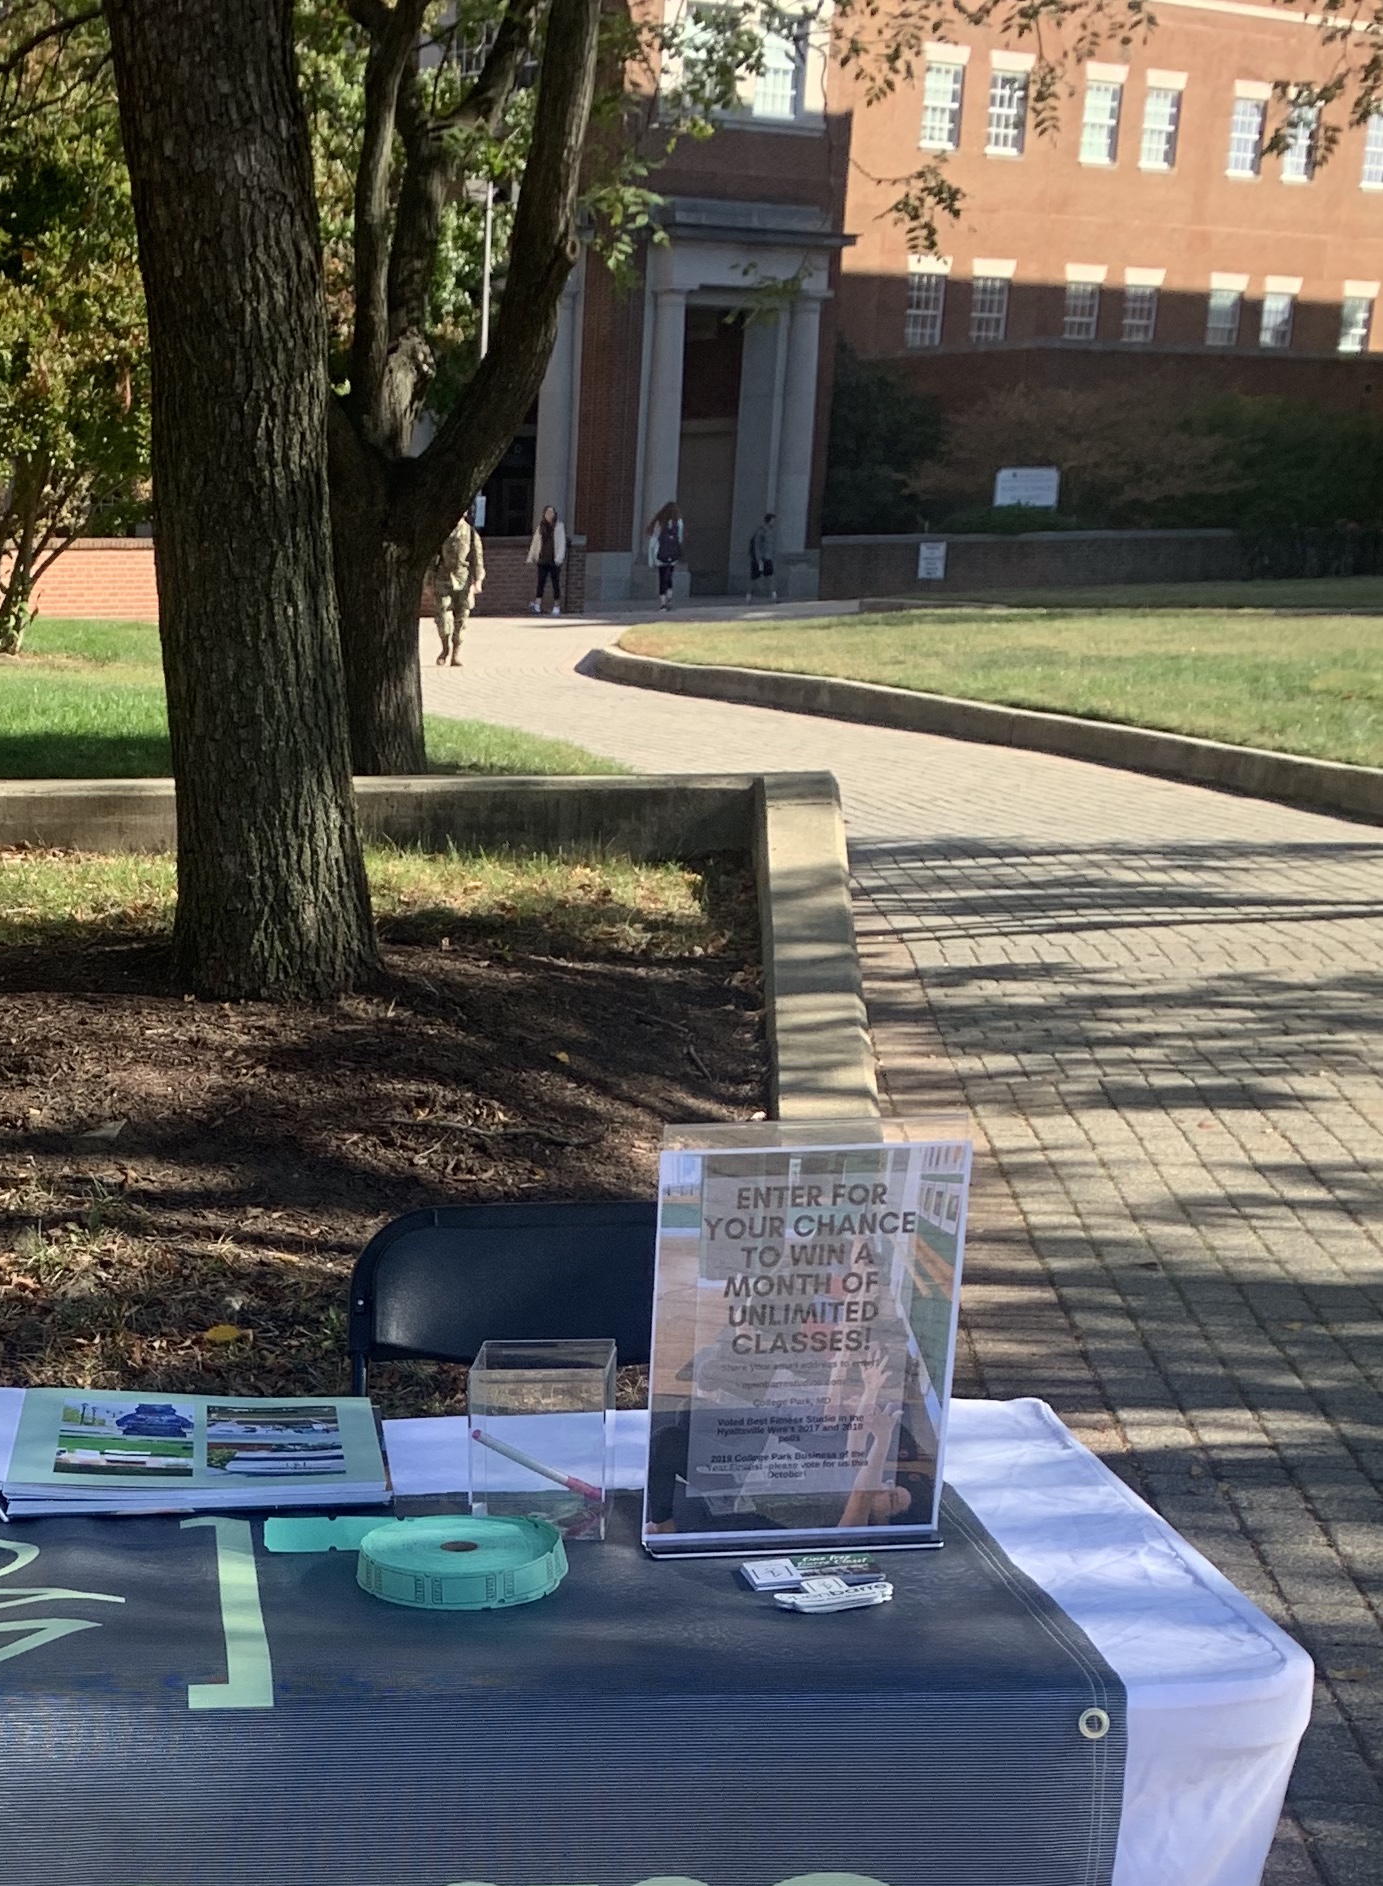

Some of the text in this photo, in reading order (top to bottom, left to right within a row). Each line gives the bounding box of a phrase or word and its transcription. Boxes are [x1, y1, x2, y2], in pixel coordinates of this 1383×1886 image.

[737, 1183, 888, 1209] ENTER FOR
[704, 1211, 916, 1241] YOUR CHANCE
[741, 1242, 874, 1268] TO WIN A
[723, 1271, 879, 1298] MONTH OF
[728, 1301, 879, 1327] UNLIMITED
[732, 1327, 871, 1355] CLASSES!
[749, 1363, 770, 1373] your
[774, 1361, 798, 1370] email
[801, 1360, 836, 1369] address
[840, 1360, 850, 1368] to
[753, 1398, 785, 1408] College
[817, 1396, 832, 1405] MD
[717, 1426, 764, 1437] Hyattsville
[797, 1424, 820, 1432] 2017
[822, 1424, 839, 1432] and
[842, 1423, 864, 1431] 2018
[718, 1418, 744, 1427] Voted
[746, 1417, 768, 1426] Best
[770, 1416, 803, 1425] Fitness
[806, 1415, 836, 1424] Studio
[849, 1414, 864, 1422] the
[735, 1454, 768, 1464] College
[771, 1452, 792, 1460] Park
[795, 1452, 836, 1460] Business
[839, 1450, 849, 1459] of
[852, 1450, 865, 1458] the
[801, 1460, 820, 1468] vote
[823, 1460, 835, 1468] for
[838, 1460, 849, 1468] us
[852, 1458, 868, 1467] this
